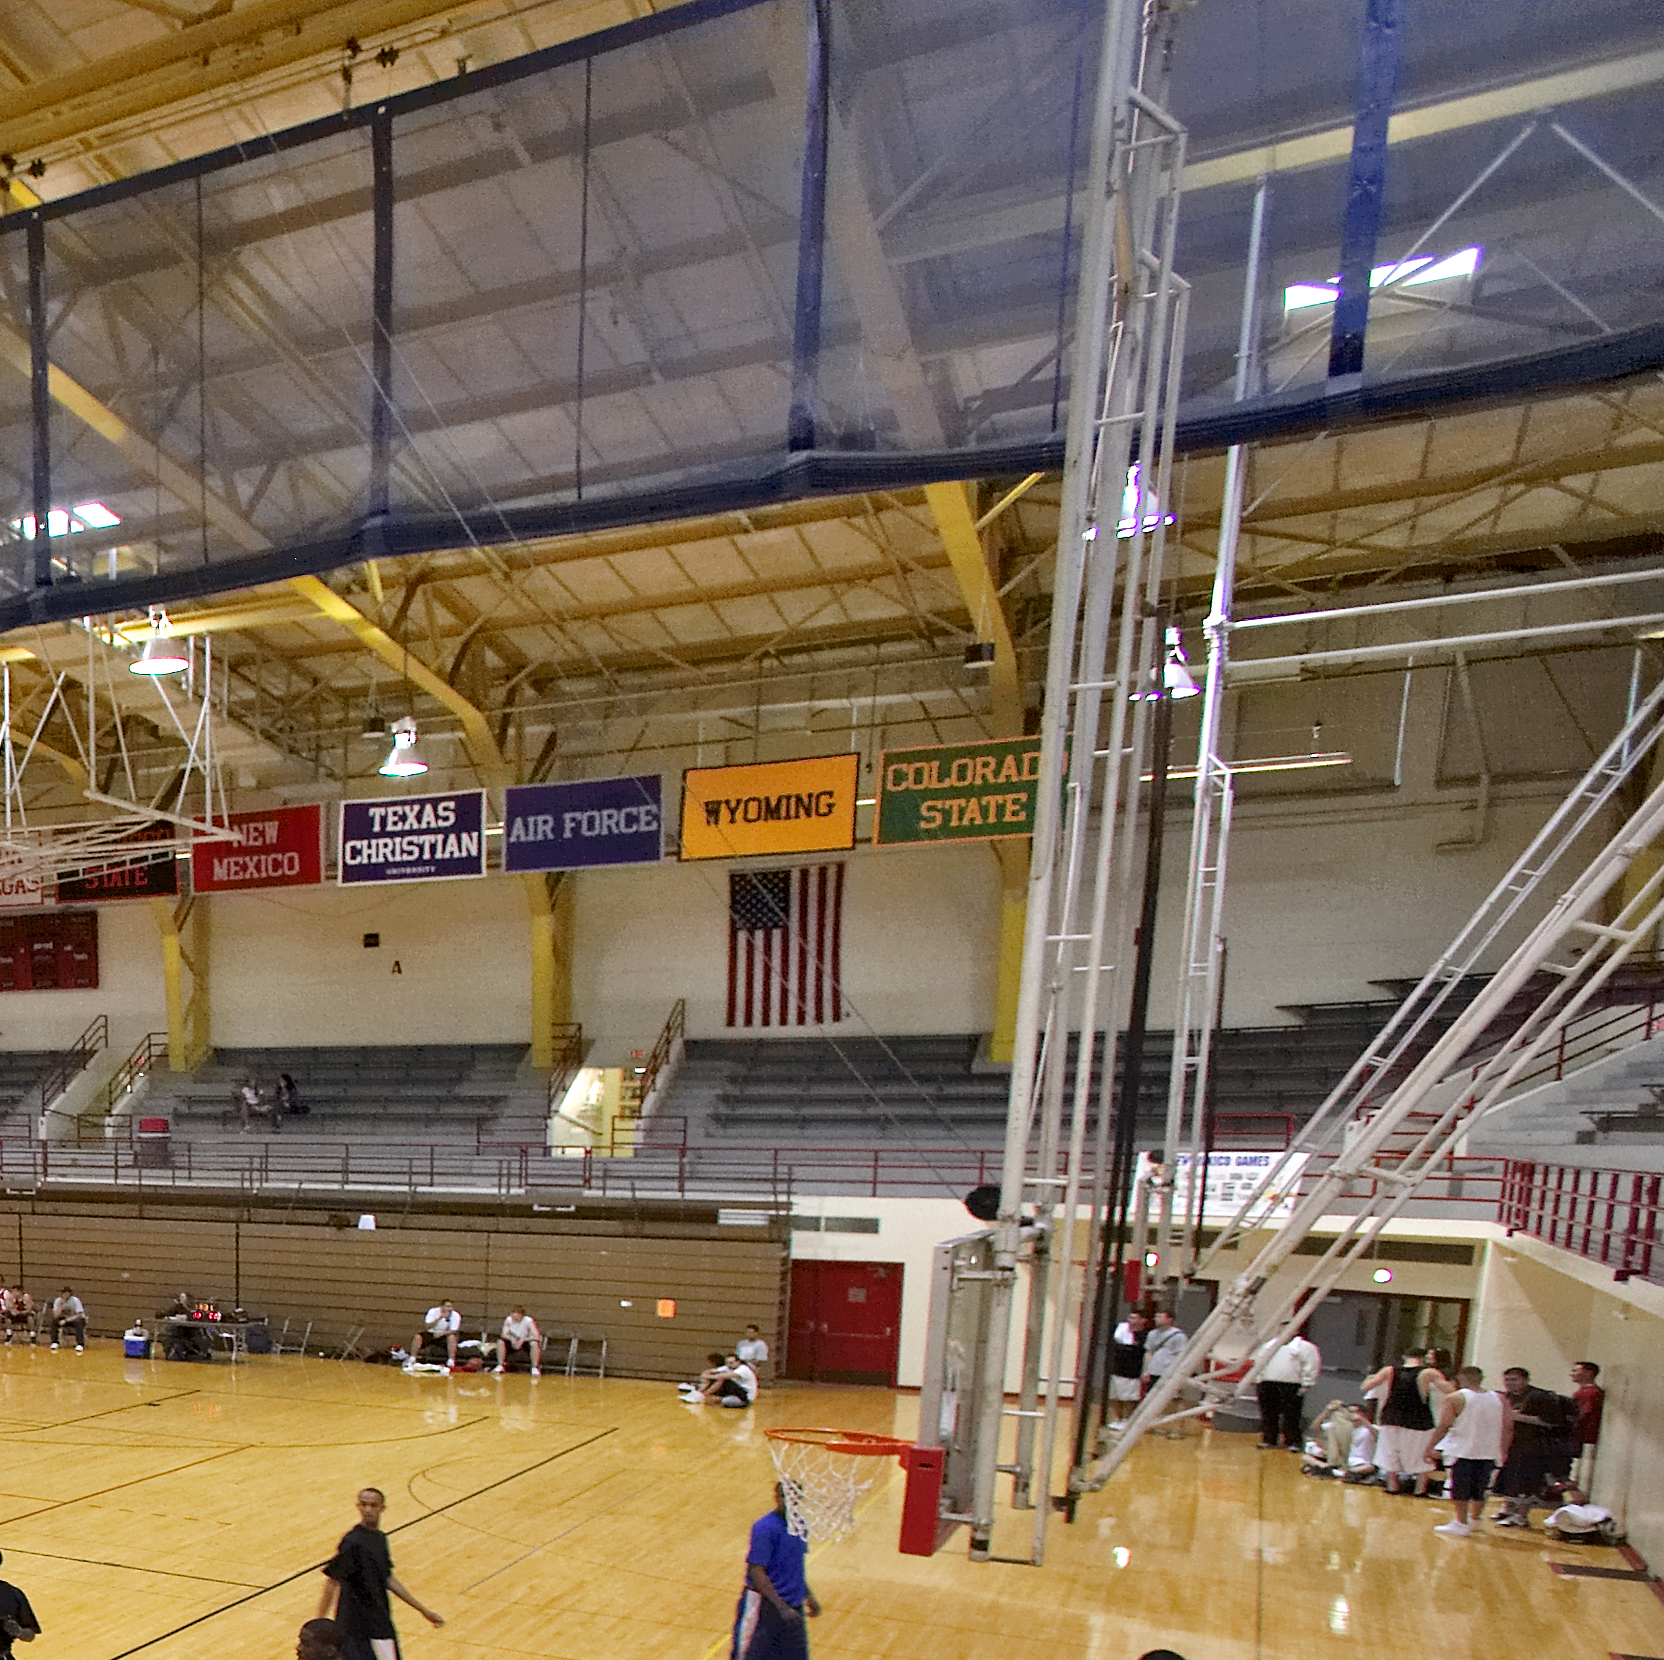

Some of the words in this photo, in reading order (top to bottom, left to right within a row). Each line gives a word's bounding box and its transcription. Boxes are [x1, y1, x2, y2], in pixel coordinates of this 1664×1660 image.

[887, 753, 1068, 792] COLORAD
[368, 801, 457, 833] TEXAS
[509, 815, 555, 843] AIR
[563, 805, 659, 838] FORCE
[704, 790, 837, 826] WYOMING
[920, 792, 1029, 829] STATE
[232, 821, 279, 848] NEW
[344, 832, 479, 866] CHRISTIAN
[84, 863, 148, 889] STATE
[213, 851, 300, 881] MEXICO
[391, 961, 402, 974] A
[1236, 1156, 1270, 1167] GAMES
